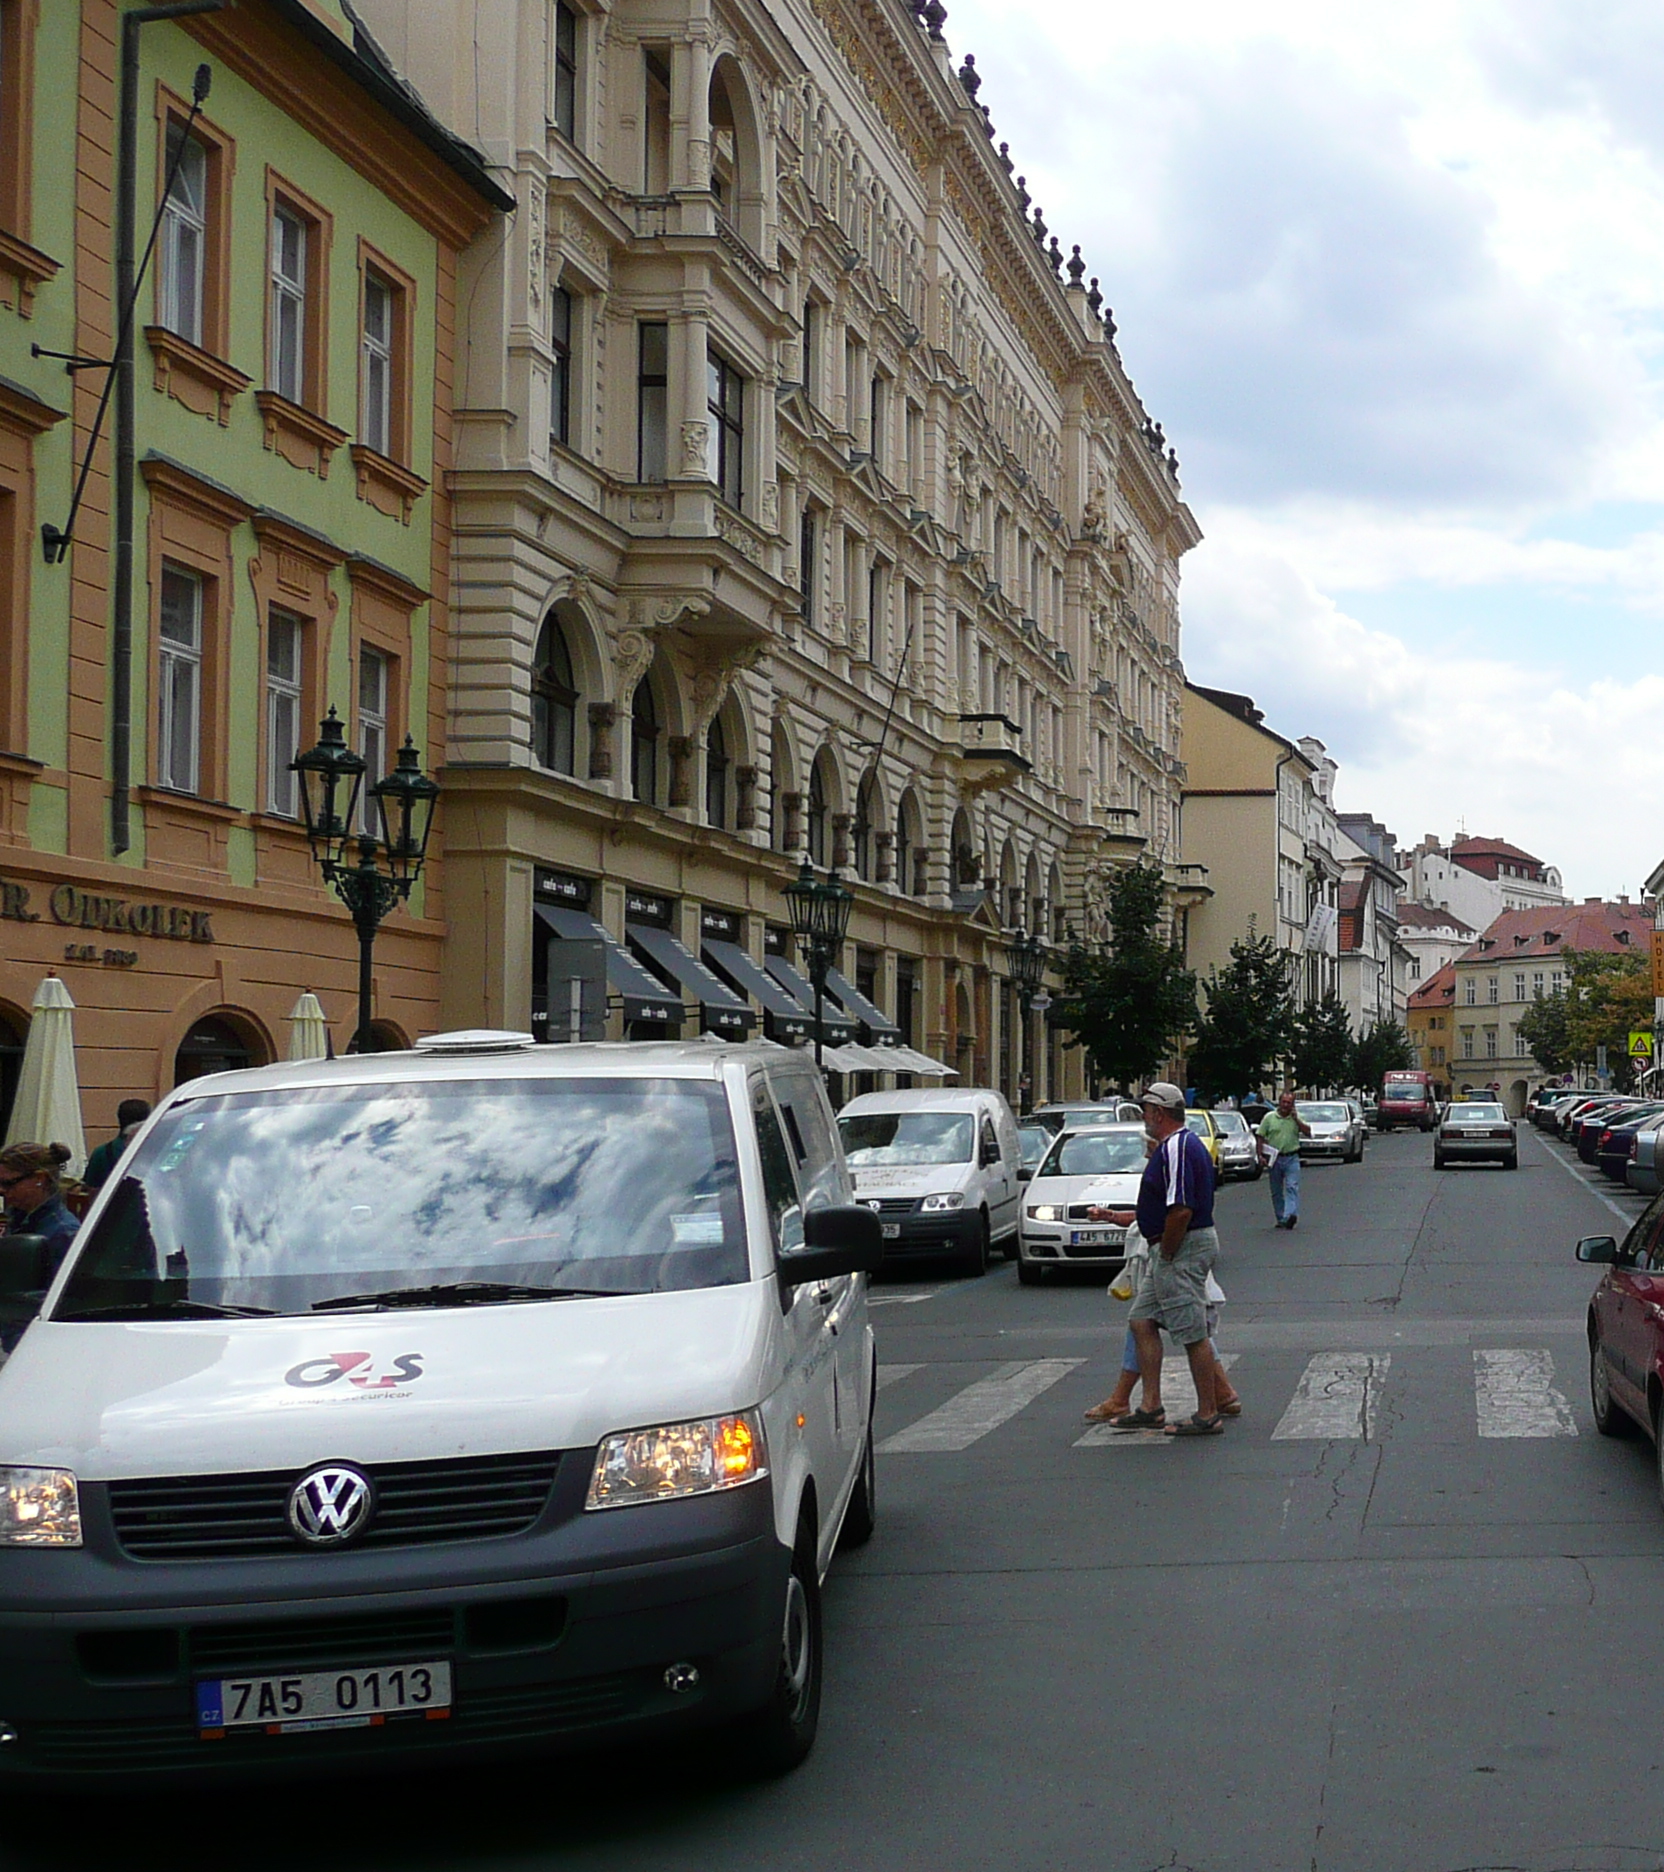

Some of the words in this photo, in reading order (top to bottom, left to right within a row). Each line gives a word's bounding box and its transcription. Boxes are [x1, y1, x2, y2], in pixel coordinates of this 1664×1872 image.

[50, 884, 215, 943] ODKOLEK
[1655, 936, 1664, 992] HOTEL
[284, 1351, 424, 1388] G4S
[201, 1710, 221, 1722] CZ
[230, 1679, 303, 1720] 7A5
[335, 1668, 432, 1711] 0113
